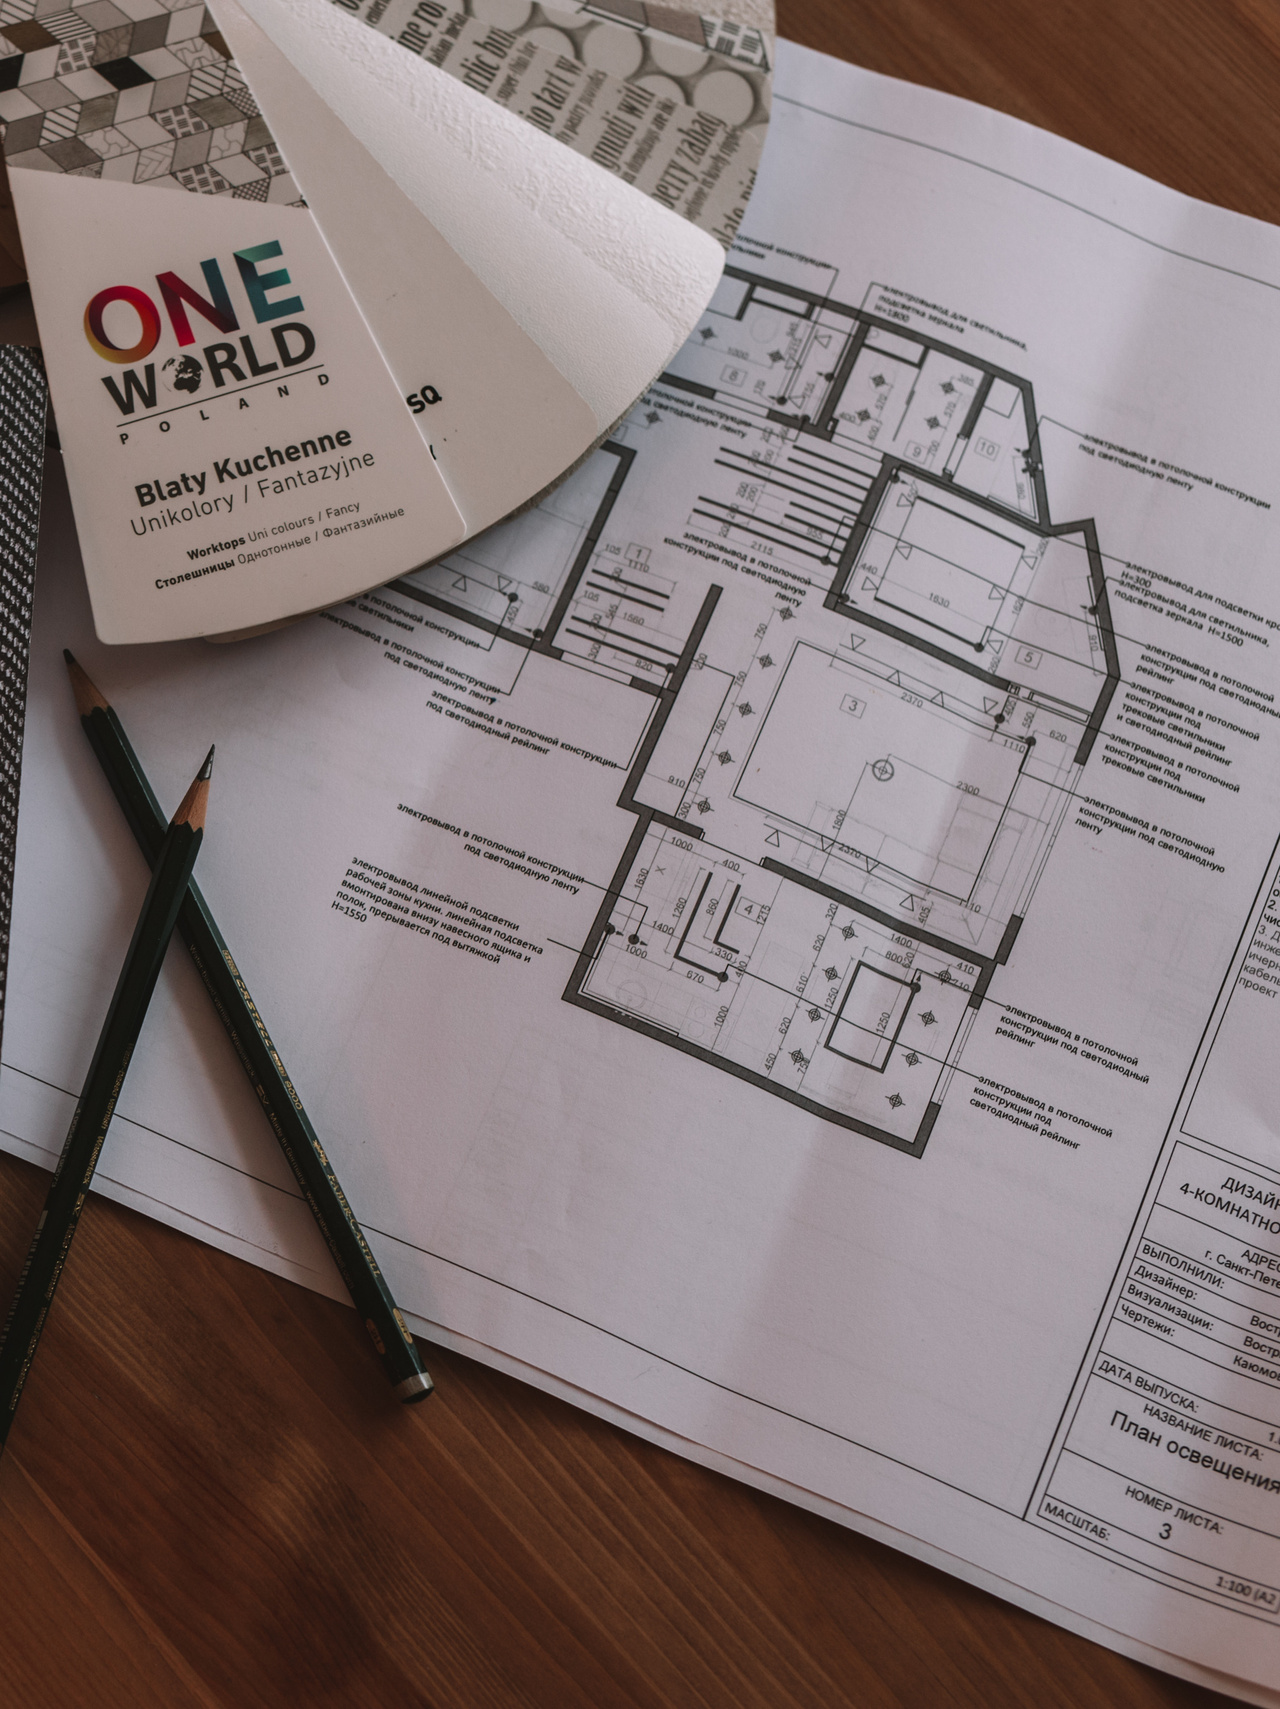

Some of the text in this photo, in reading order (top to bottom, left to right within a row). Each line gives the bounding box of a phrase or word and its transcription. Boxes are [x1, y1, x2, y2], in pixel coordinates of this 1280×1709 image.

[84, 240, 304, 364] ONE
[119, 373, 330, 446] POLAND
[130, 453, 374, 535] Unikolory / Fantazyjne
[134, 429, 352, 507] Blaty Kuchenne
[154, 508, 404, 589] Столешницы Однотонные / Фантазийные
[186, 502, 359, 560] Worktops Uni colours / Fancy
[425, 700, 550, 754] под светодиодный рейлинг
[431, 690, 617, 768] электровывод в потолочной конструкции
[1074, 818, 1102, 835] ленту
[1078, 806, 1225, 873] конструкции под светодиодную
[1083, 796, 1214, 856] электровывод в потолочной
[345, 868, 543, 954] рабочей зоны кухни. линейная подсветка
[351, 856, 519, 931] электровывод линейной подсветки
[335, 890, 500, 963] полок, прерывается под вытяжкой
[341, 879, 531, 963] вмонтирована внизу навесного ящика и
[1238, 977, 1278, 999] проект
[969, 1098, 1080, 1149] светодиодный рейлинг
[973, 1086, 1051, 1126] конструкции под
[978, 1075, 1045, 1110] электровывод
[1055, 1108, 1112, 1137] потолочной
[1133, 1265, 1197, 1298] Дизайнер:
[1142, 1243, 1224, 1288] ВЫПОЛНИЛИ:
[1121, 1303, 1175, 1336] Чертежи:
[1127, 1283, 1213, 1329] Визуализации:
[1243, 1335, 1280, 1358] Востр
[1098, 1359, 1198, 1413] ДАТА ВЫПУСКА:
[1110, 1410, 1162, 1446] План
[1142, 1403, 1263, 1460] НАЗВАНИЕ ЛИСТА:
[1044, 1502, 1110, 1540] МАСШТАБ:
[1124, 1485, 1223, 1534] НОМЕР ЛИСТА:
[1158, 1523, 1172, 1540] 3
[1215, 1575, 1252, 1596] 1:100
